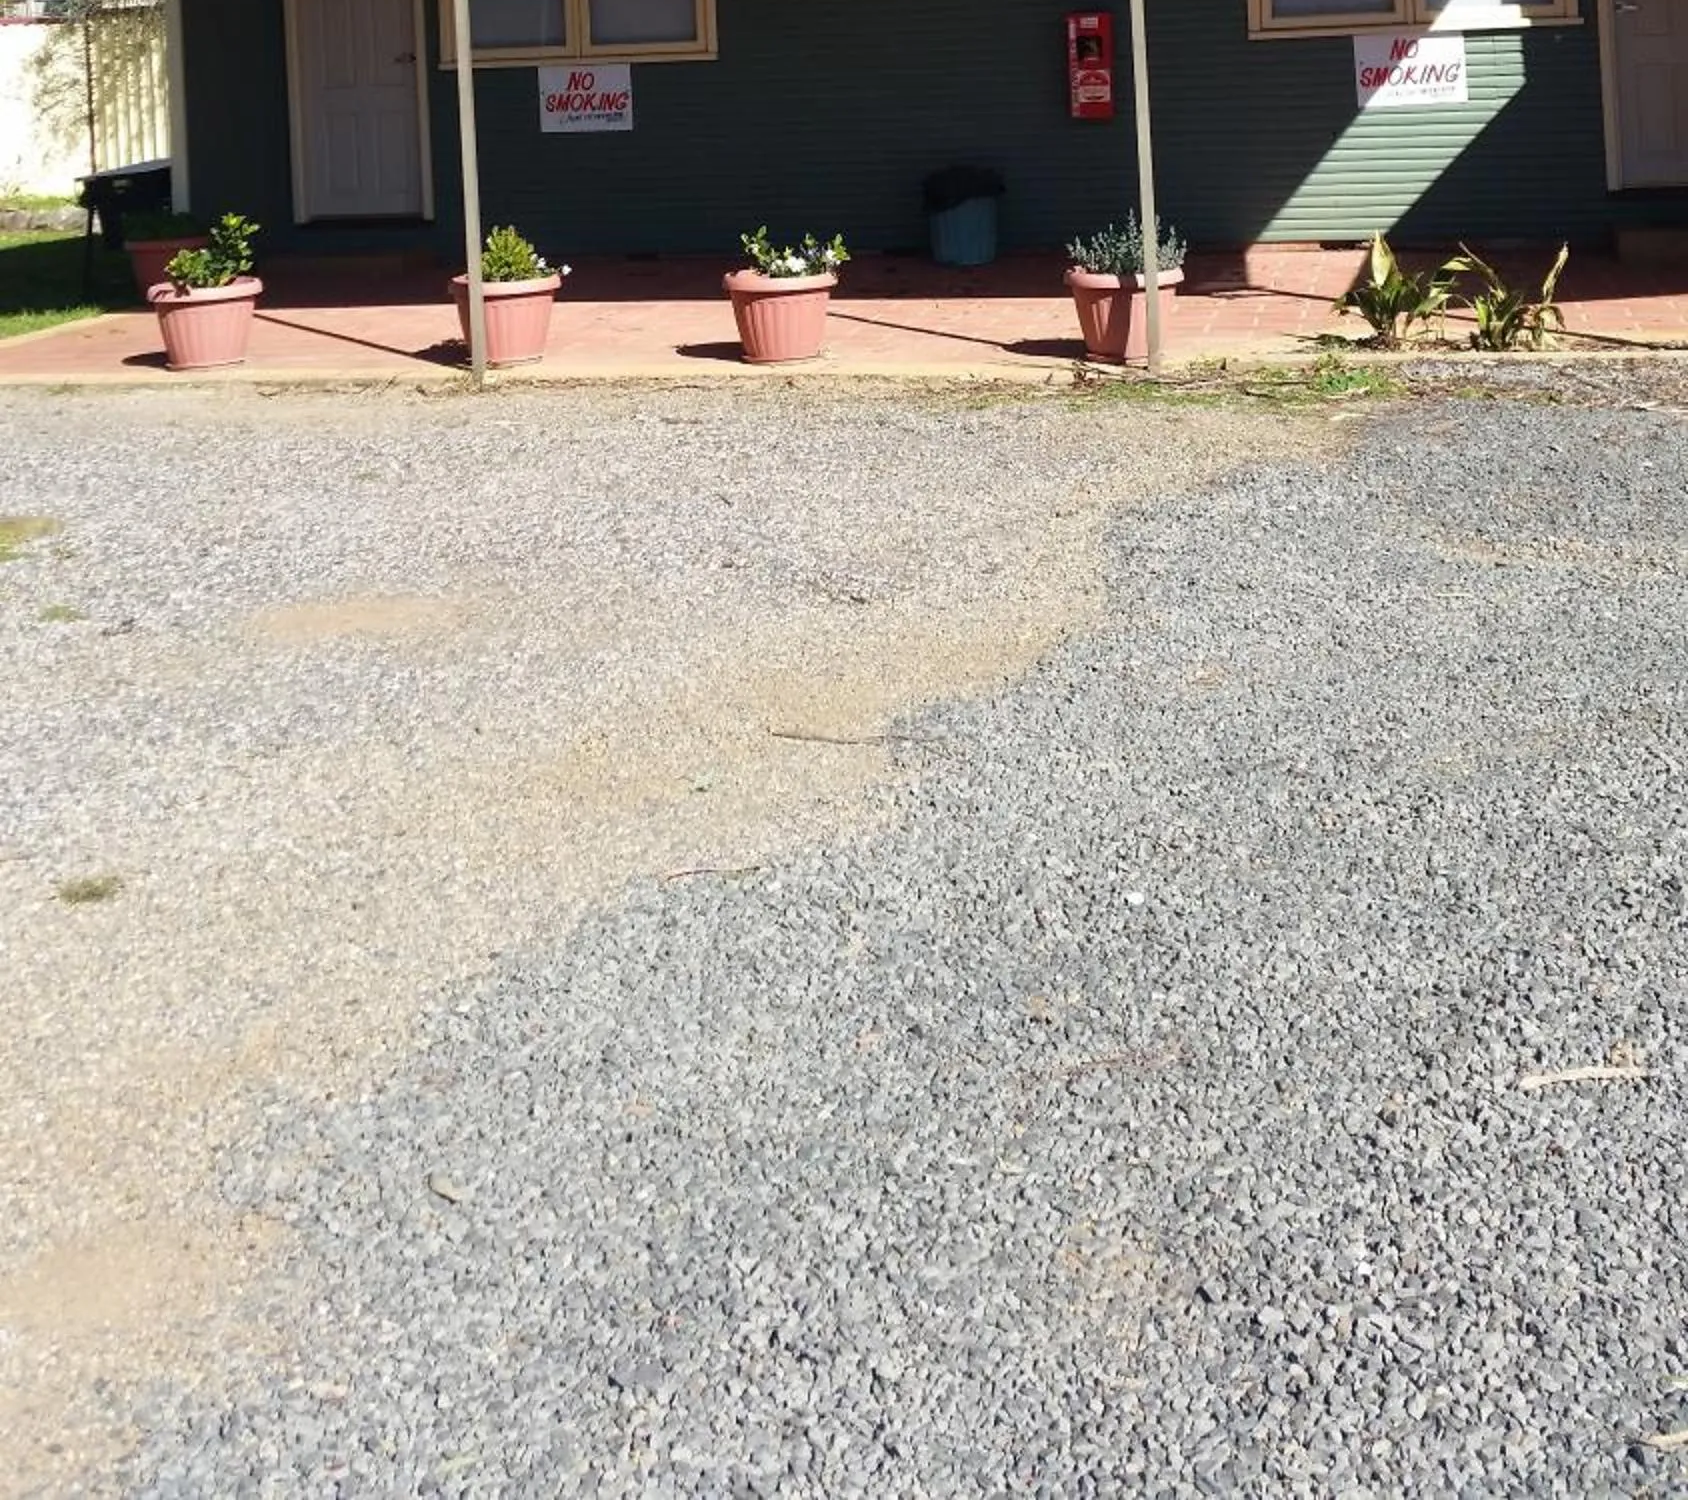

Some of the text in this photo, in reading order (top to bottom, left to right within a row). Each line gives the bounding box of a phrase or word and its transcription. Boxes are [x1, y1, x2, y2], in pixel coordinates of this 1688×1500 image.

[1389, 38, 1419, 60] NO
[567, 71, 595, 90] NO
[1360, 63, 1461, 88] SMOKING
[545, 92, 629, 113] SMOKING
